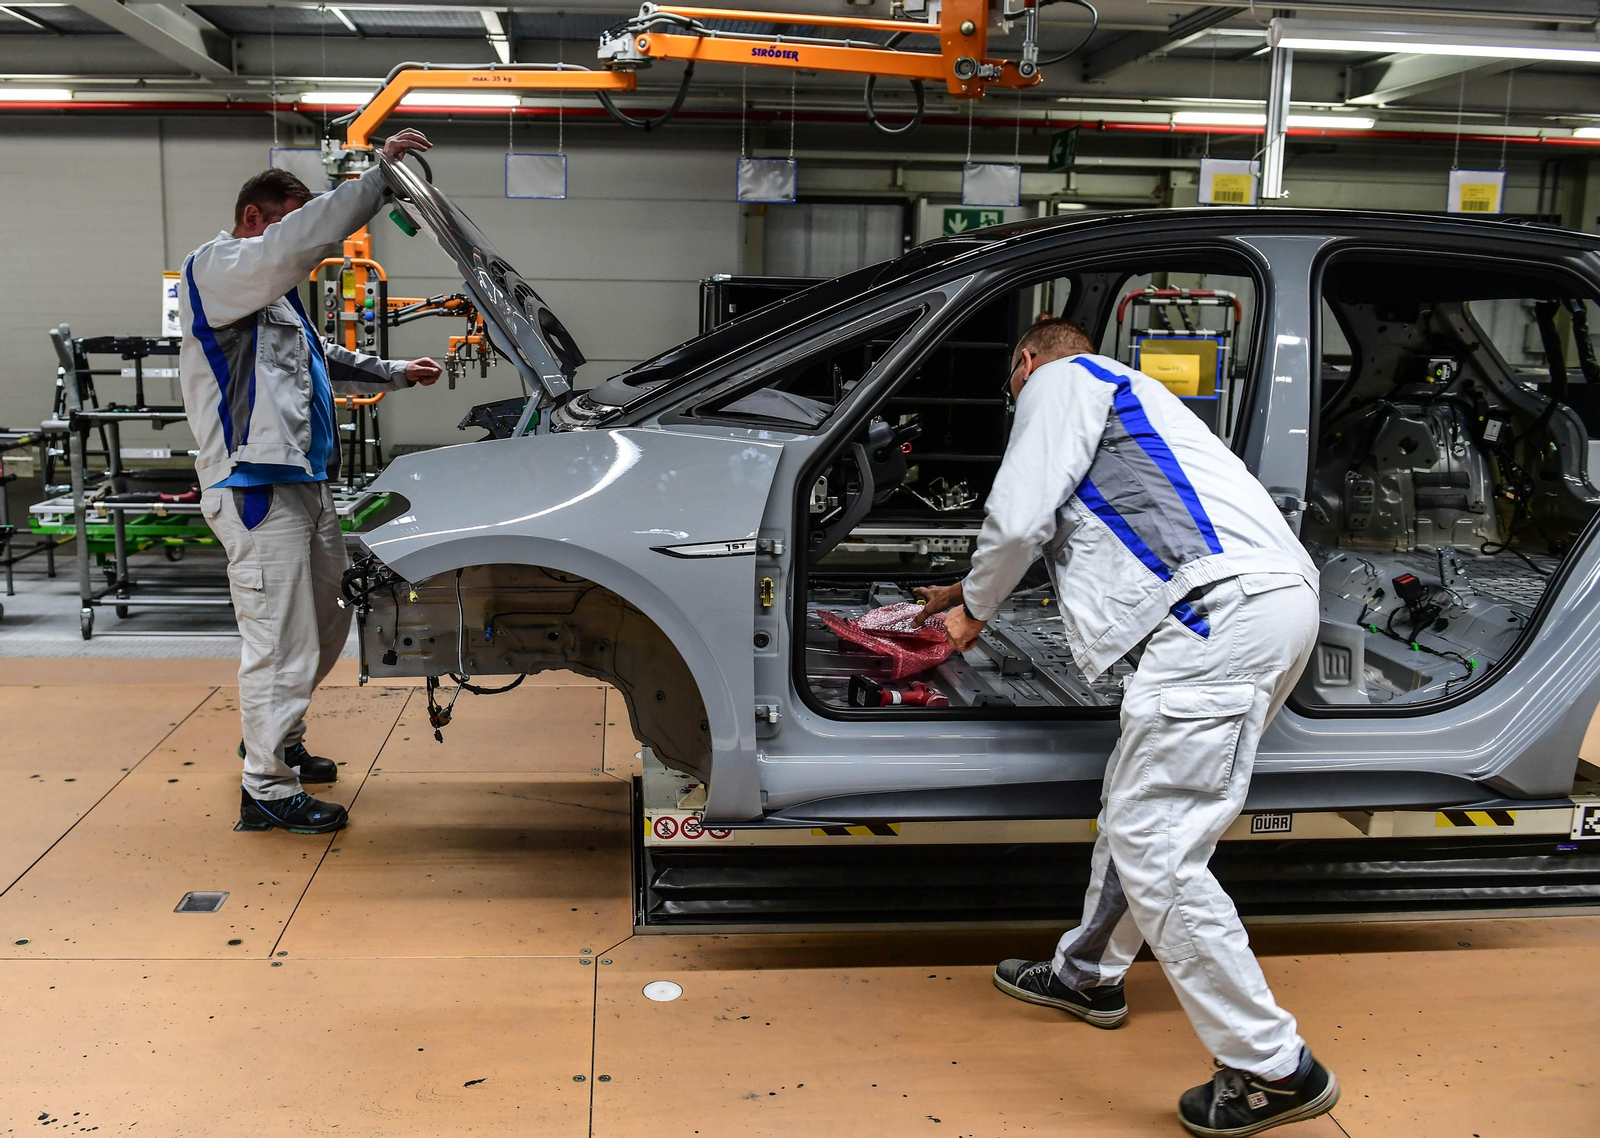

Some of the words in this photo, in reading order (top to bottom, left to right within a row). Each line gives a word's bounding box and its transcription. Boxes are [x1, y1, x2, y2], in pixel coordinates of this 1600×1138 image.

[751, 45, 799, 62] STRÖDTER
[503, 75, 513, 83] kg
[725, 543, 747, 551] 1ST
[1255, 814, 1289, 830] DÜRR
